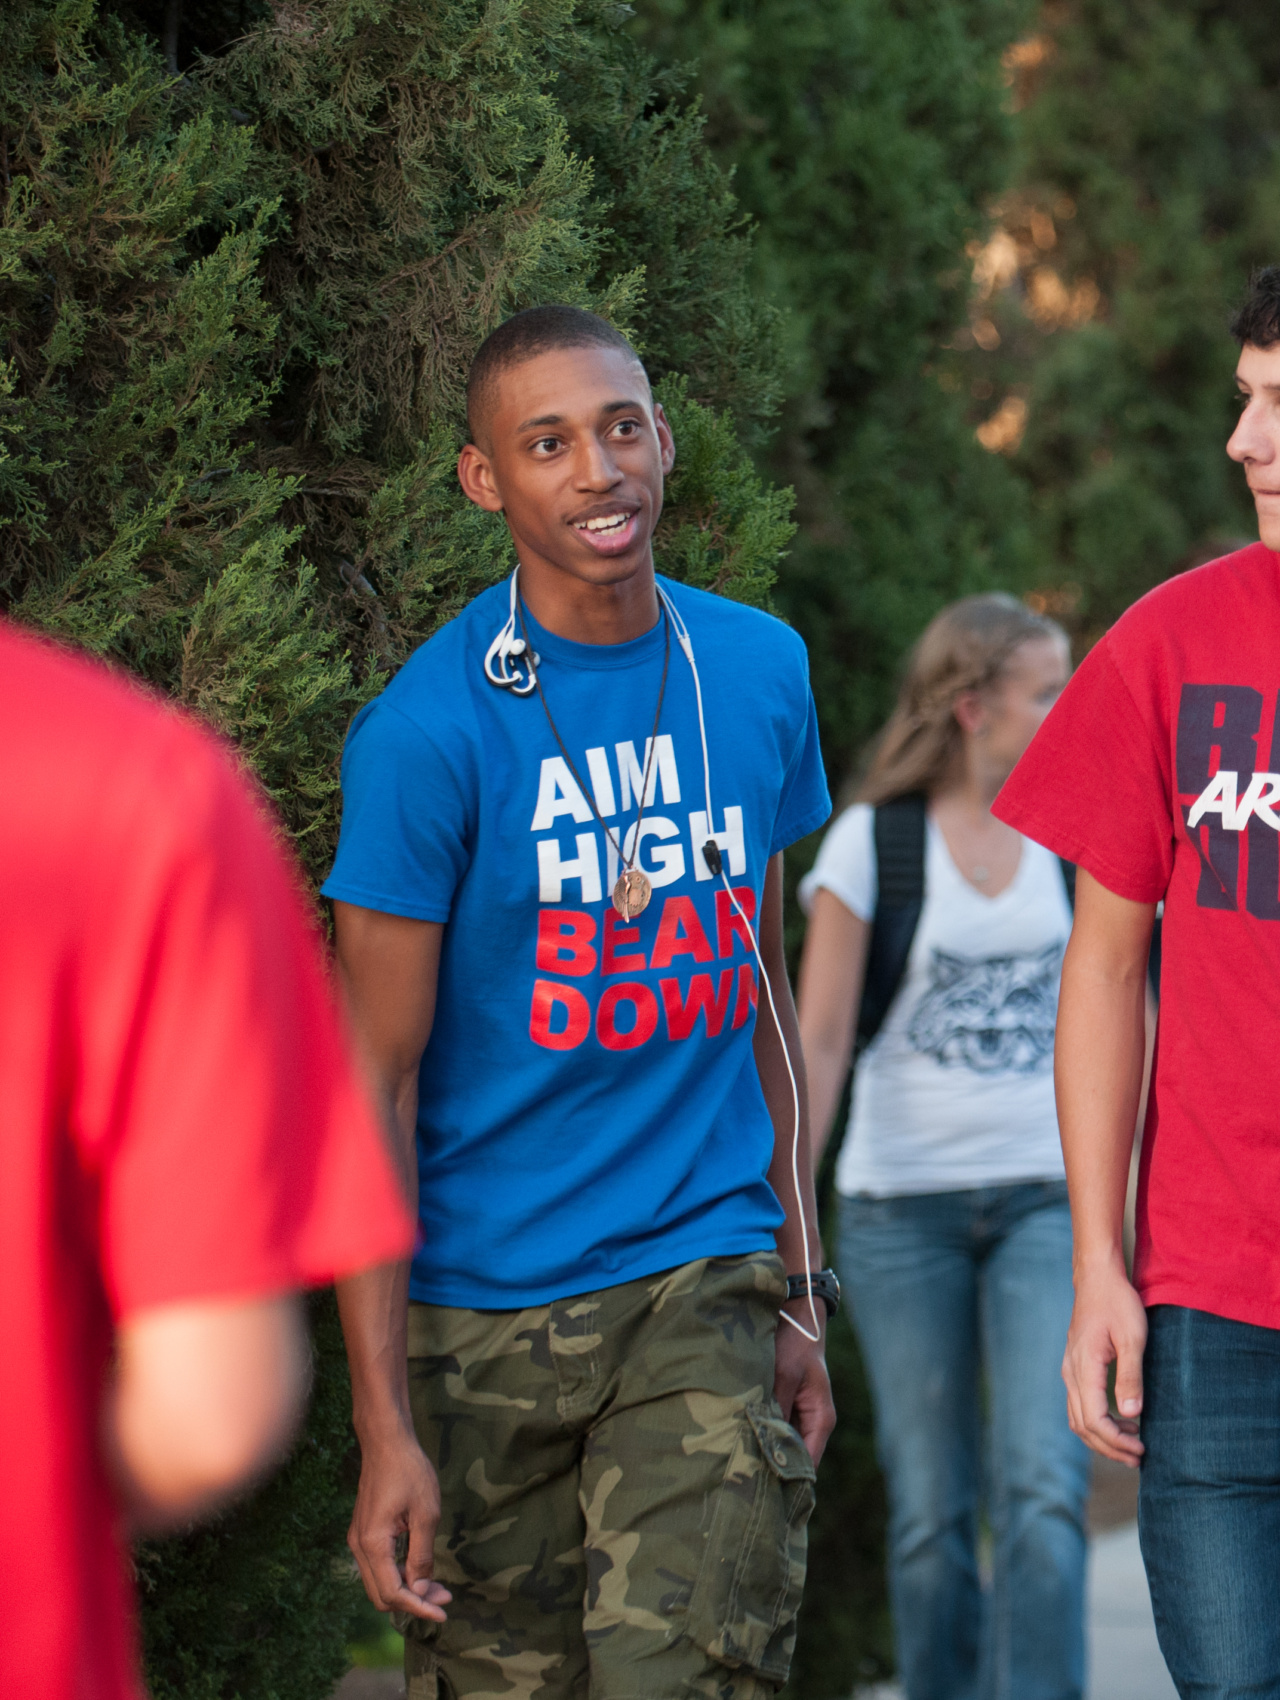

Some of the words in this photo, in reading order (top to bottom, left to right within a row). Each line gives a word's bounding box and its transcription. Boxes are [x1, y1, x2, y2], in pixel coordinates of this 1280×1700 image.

[530, 734, 681, 831] AIM
[536, 805, 746, 903] HIGH
[536, 886, 758, 977] BEAR
